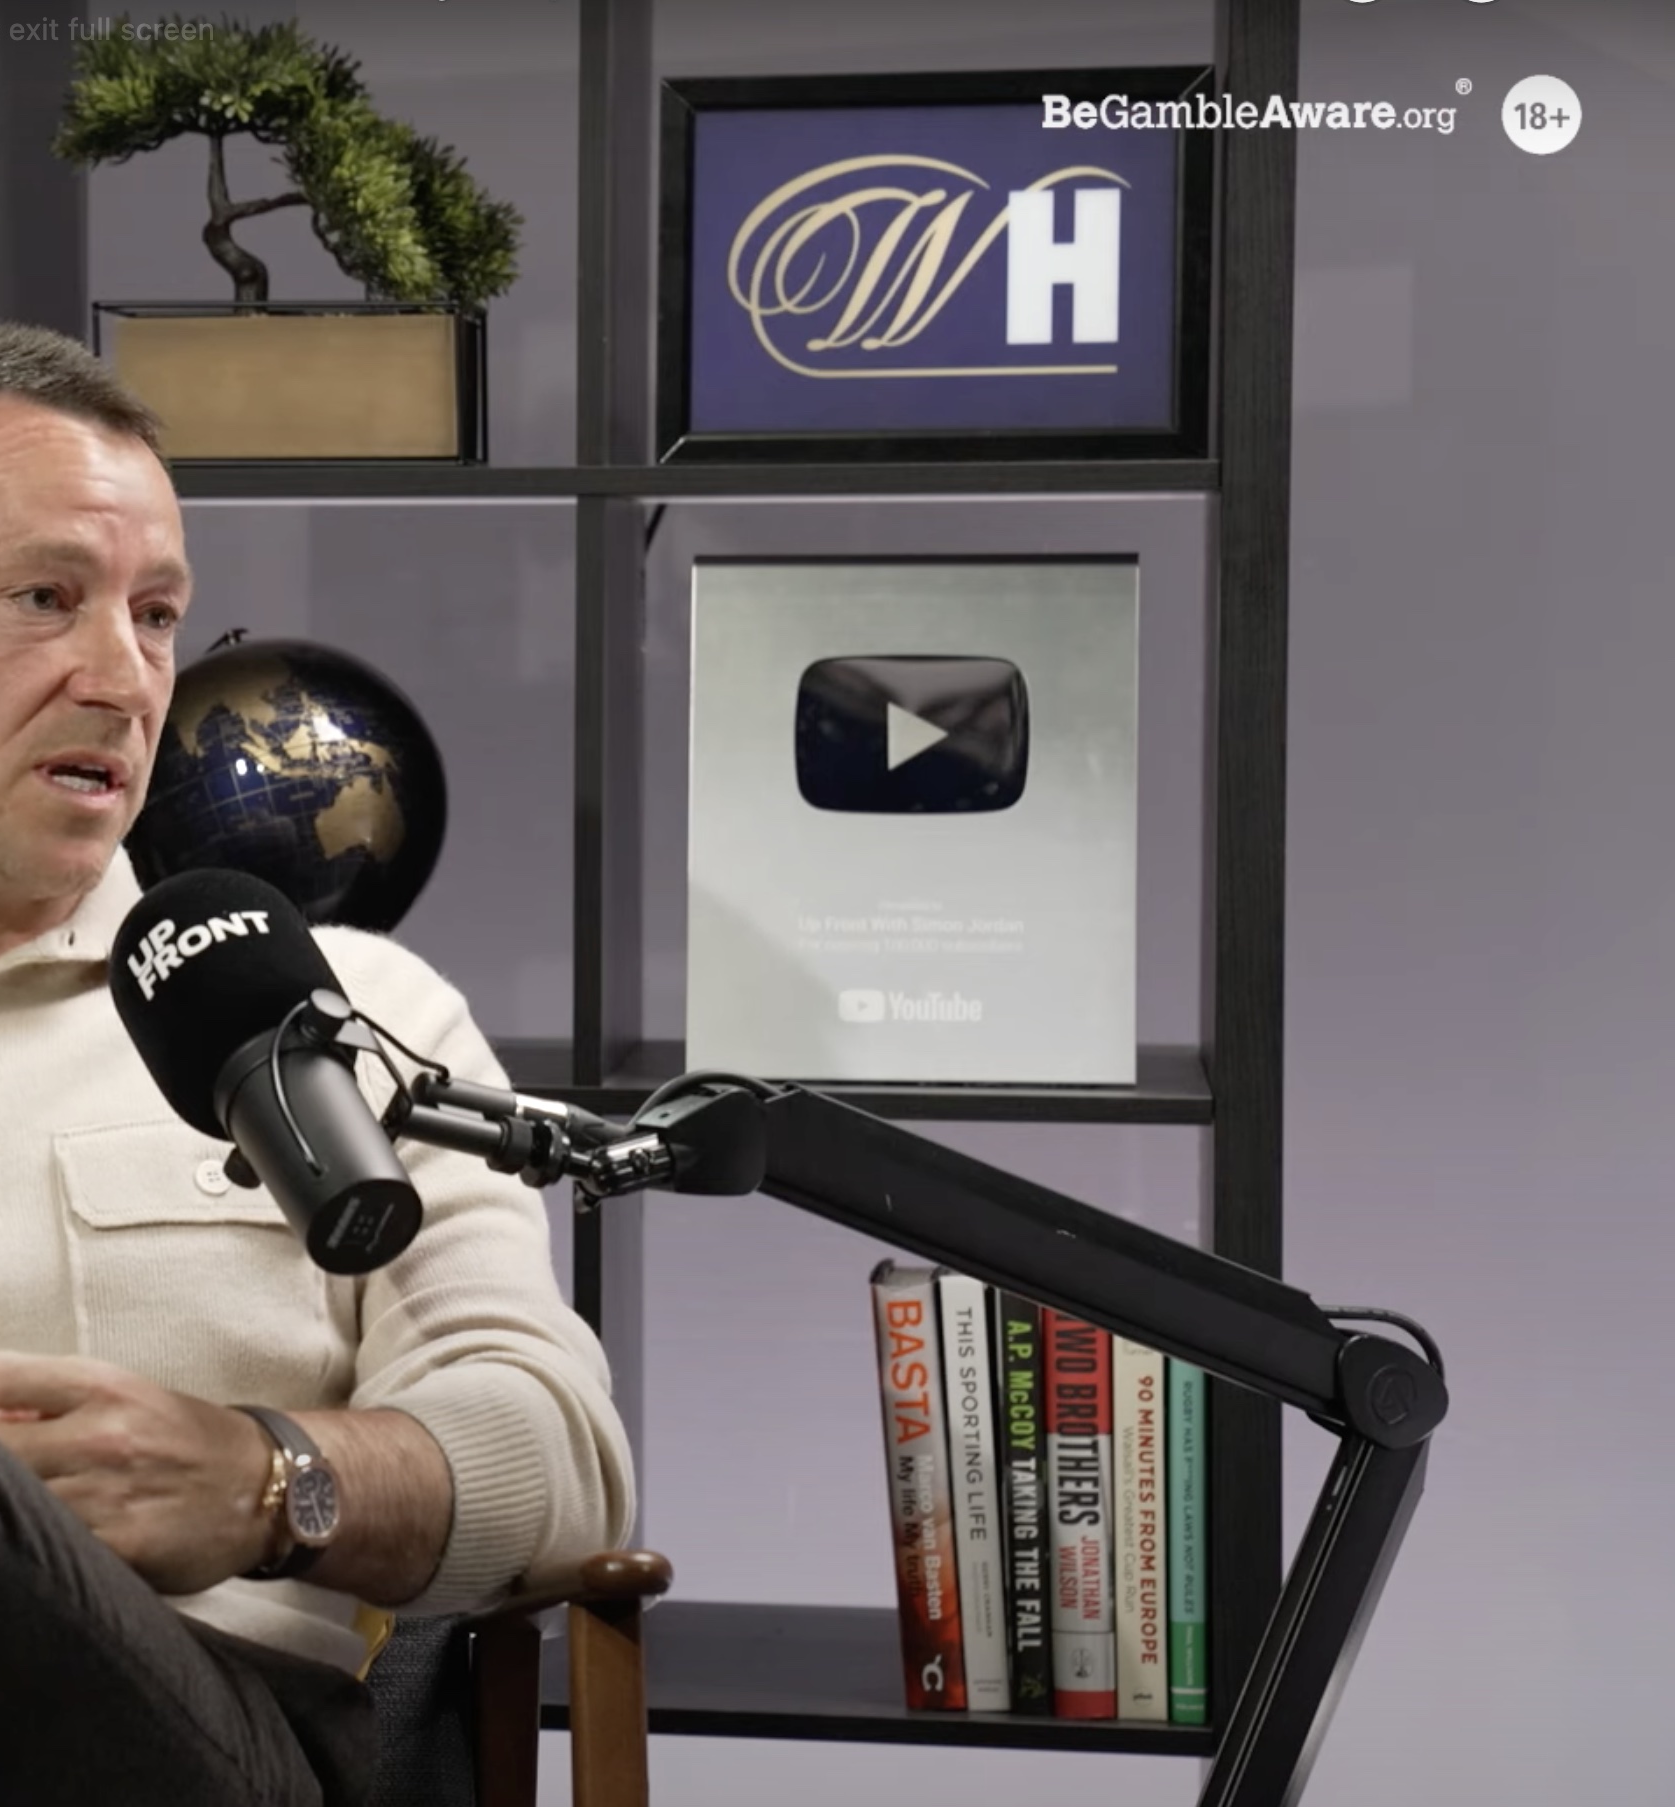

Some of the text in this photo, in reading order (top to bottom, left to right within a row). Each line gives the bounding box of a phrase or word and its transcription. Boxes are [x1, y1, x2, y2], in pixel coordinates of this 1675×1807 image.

[127, 918, 176, 979] UP
[798, 916, 1025, 934] Up Front With Simon Jordan
[136, 911, 270, 1001] FRONT
[889, 991, 983, 1023] YouTube
[956, 1307, 975, 1358] THIS
[885, 1299, 932, 1446] BASTA
[1006, 1320, 1036, 1450] A.P. McCOY
[1138, 1375, 1154, 1402] 90
[1183, 1381, 1193, 1423] RUGBY
[959, 1367, 983, 1484] SPORTING
[1056, 1383, 1100, 1527] BROTHERS
[1183, 1428, 1193, 1452] HAS
[896, 1456, 916, 1483] My
[1138, 1409, 1156, 1503] MINUTES
[898, 1489, 916, 1516] life
[967, 1490, 987, 1542] LIFE
[1123, 1489, 1135, 1549] Greatest
[1183, 1505, 1194, 1540] LAWS
[916, 1454, 943, 1621] Marco van Basten
[1011, 1457, 1043, 1653] TAKING THE FALL
[1122, 1552, 1135, 1580] Cup
[1139, 1509, 1156, 1572] FROM
[1059, 1546, 1077, 1611] WILSON
[1081, 1535, 1101, 1621] JONATHAN
[1124, 1585, 1135, 1614] Run
[1140, 1578, 1158, 1665] EUROPE
